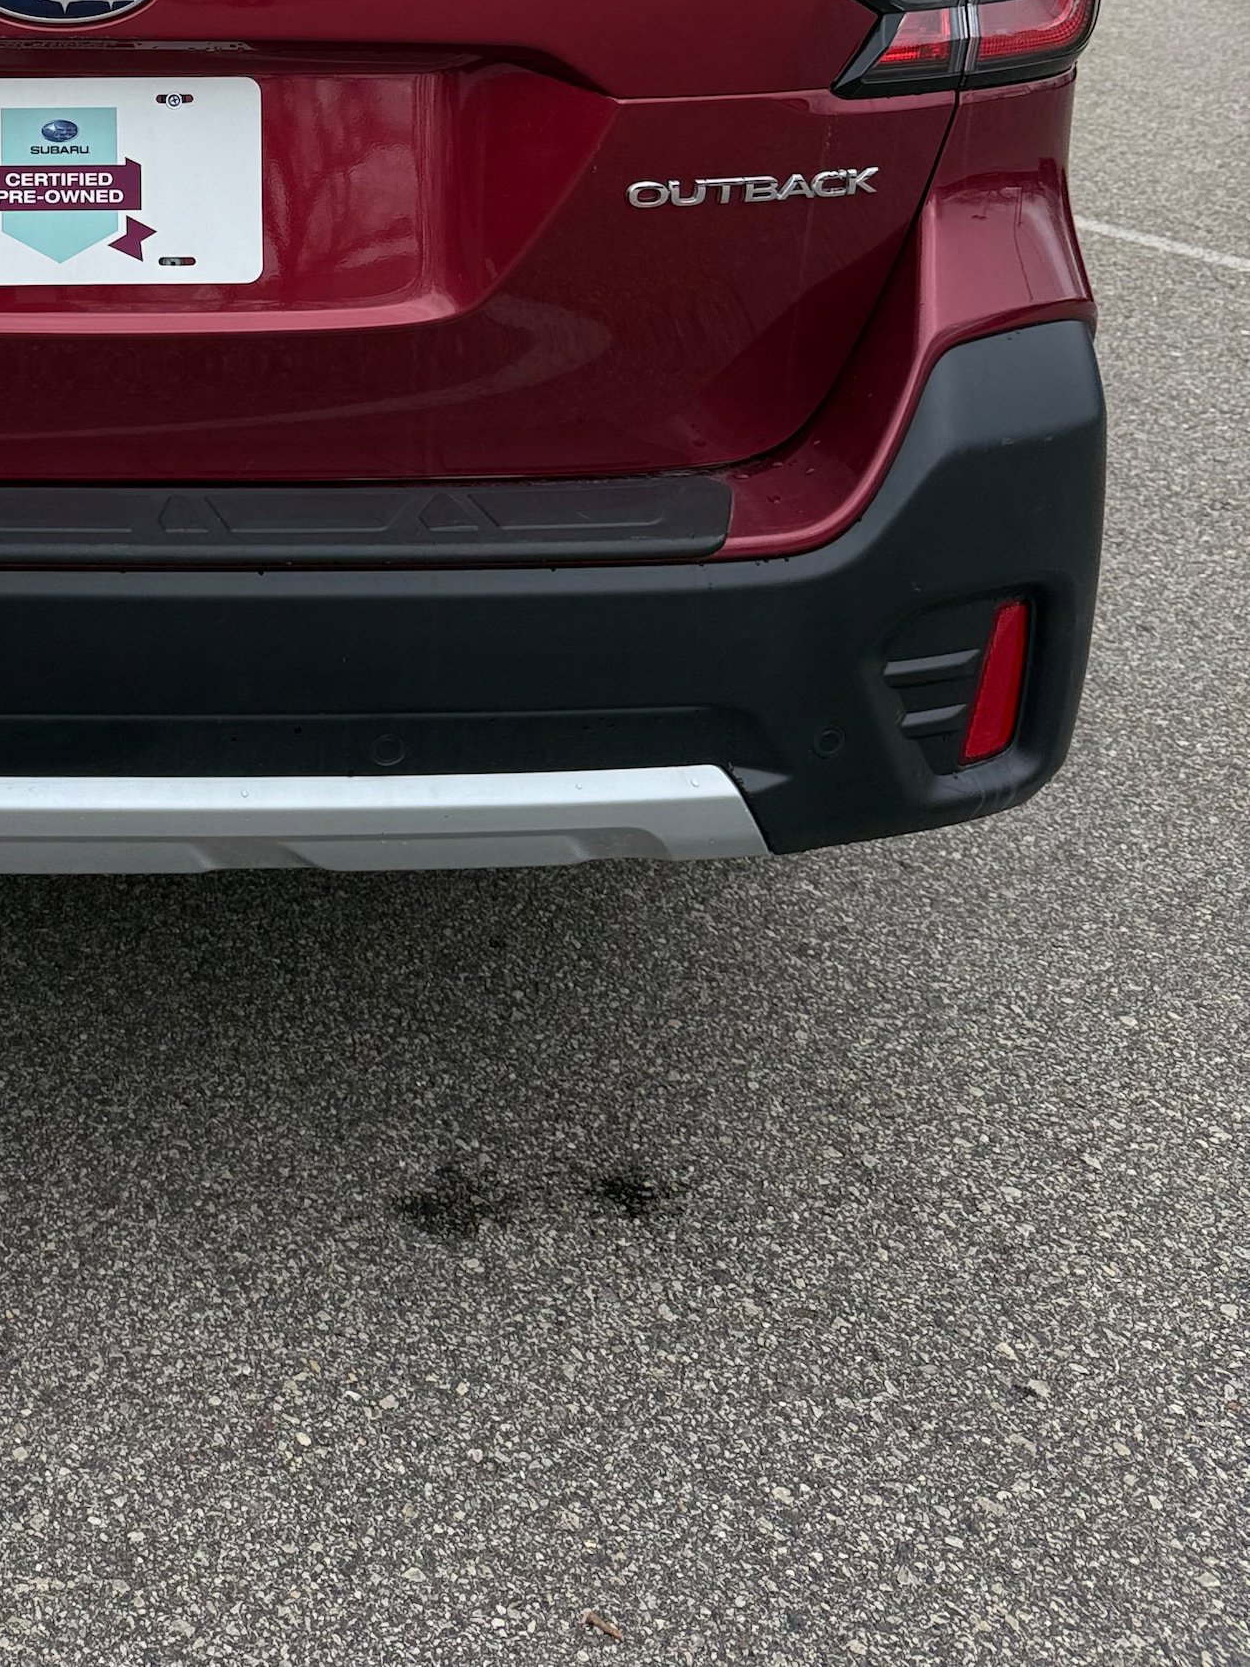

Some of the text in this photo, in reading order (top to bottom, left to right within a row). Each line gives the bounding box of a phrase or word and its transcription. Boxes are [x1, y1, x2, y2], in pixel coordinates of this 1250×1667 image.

[30, 145, 90, 155] SUBARU
[5, 172, 113, 187] CERTIFIED
[626, 166, 879, 209] OUTBACK
